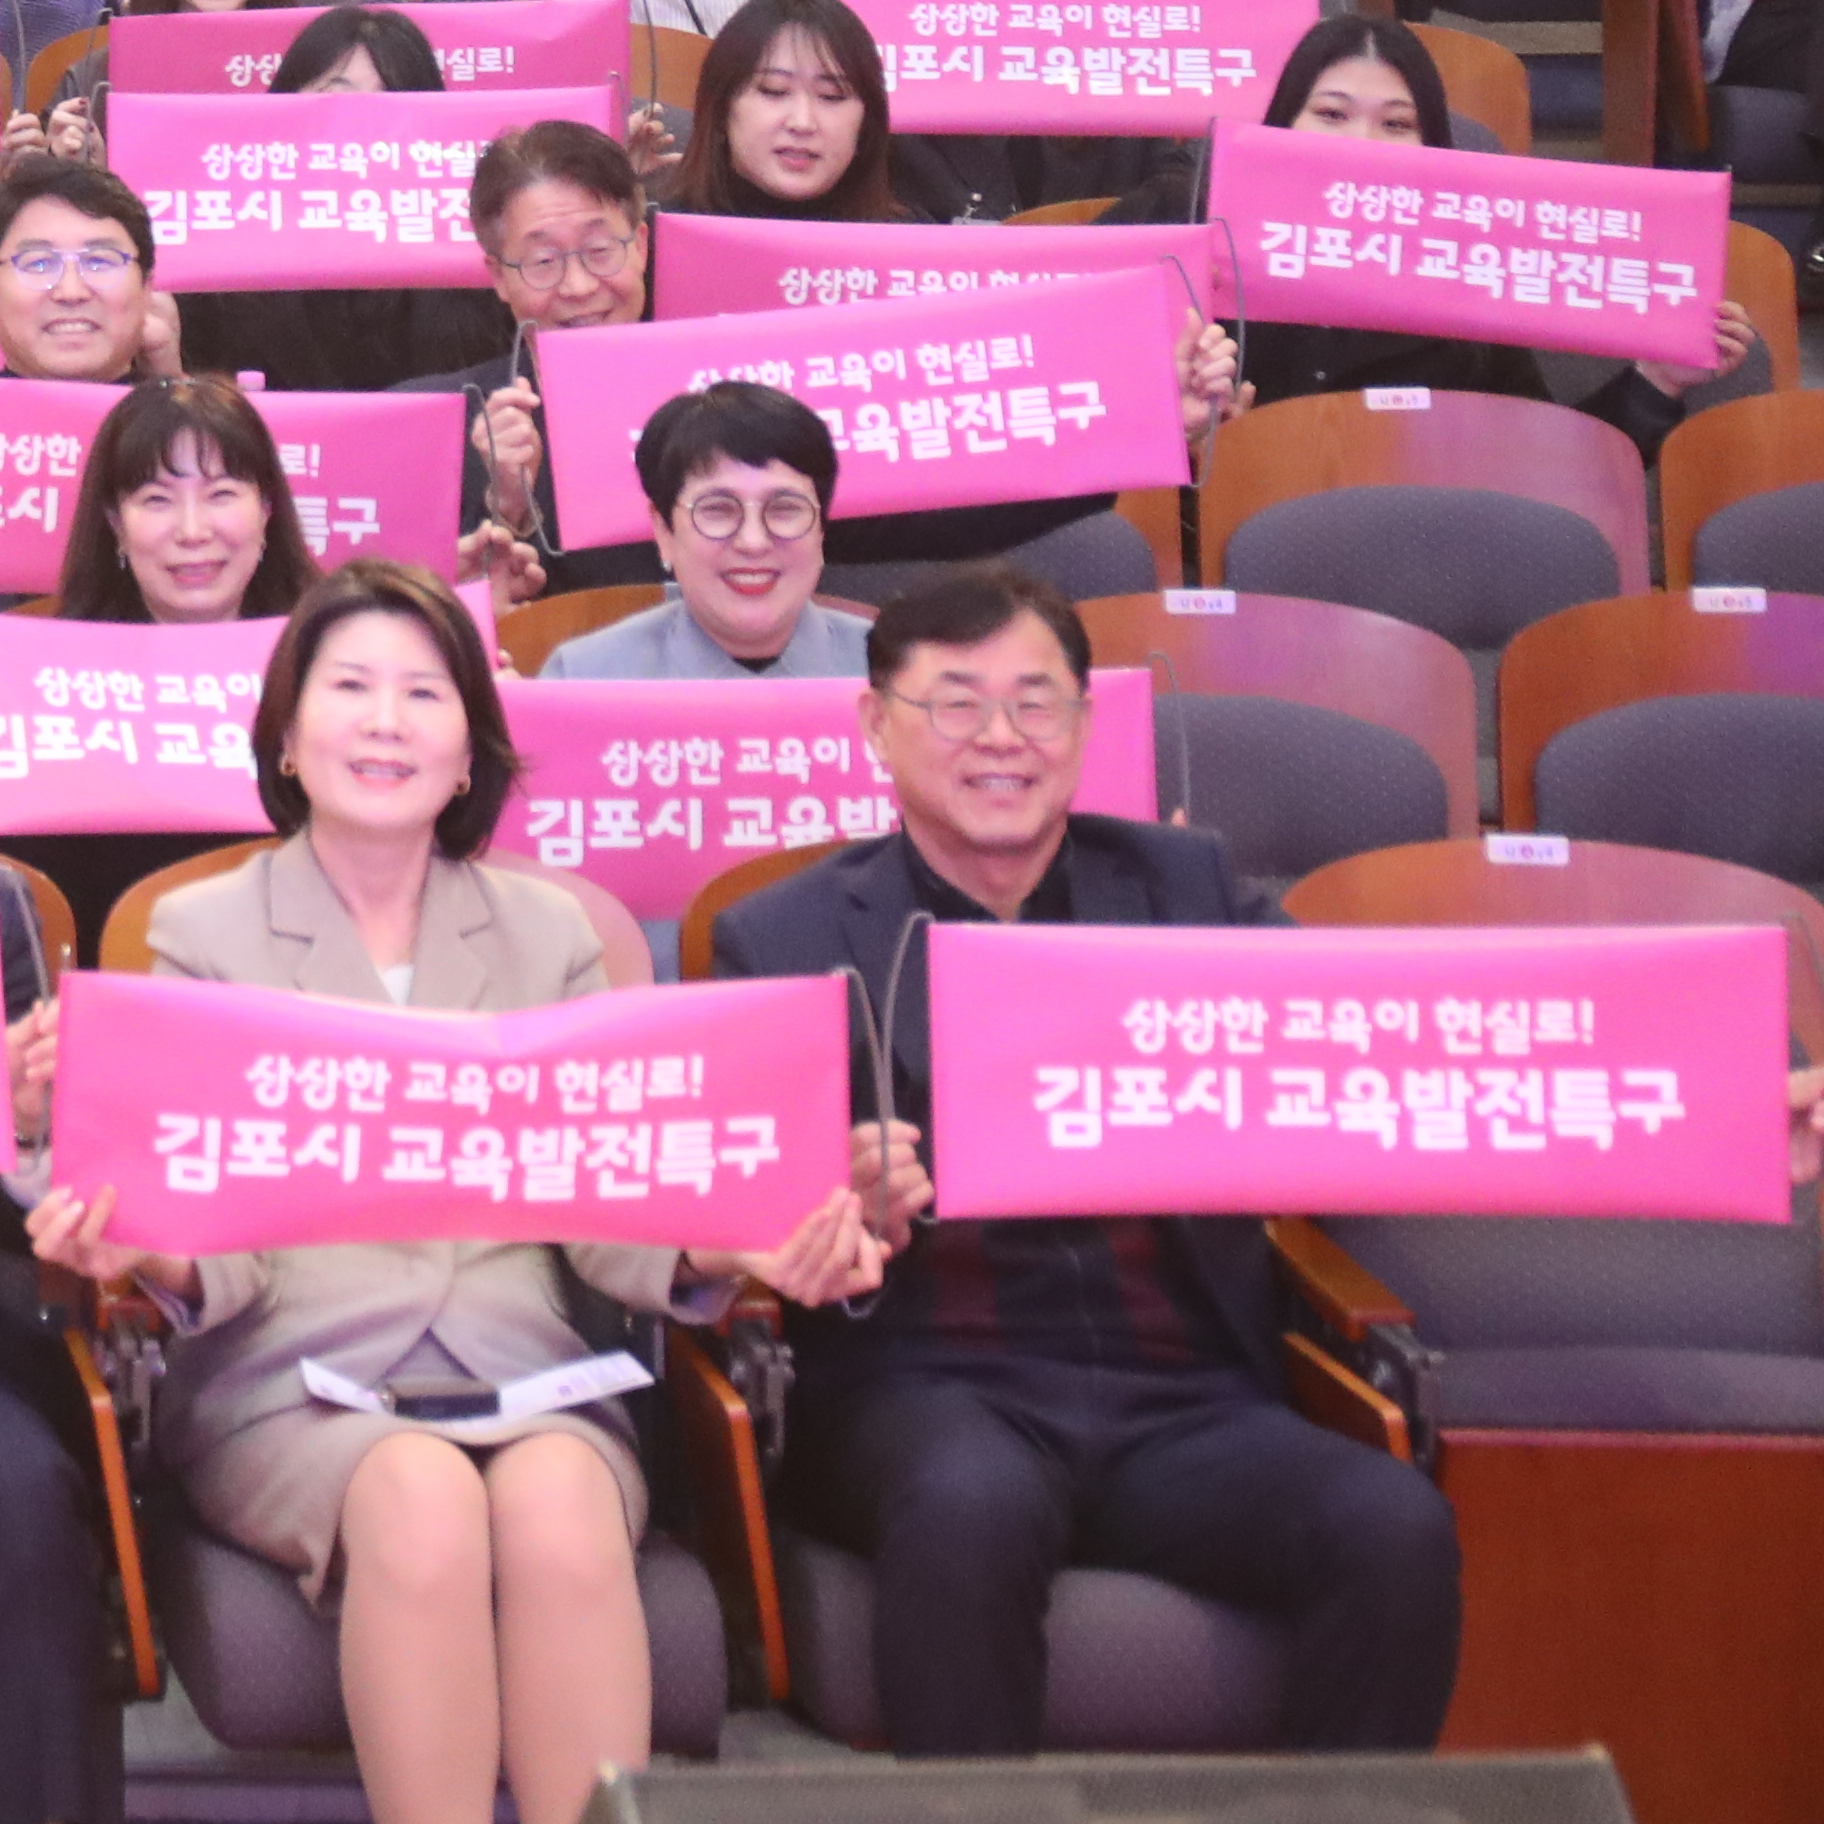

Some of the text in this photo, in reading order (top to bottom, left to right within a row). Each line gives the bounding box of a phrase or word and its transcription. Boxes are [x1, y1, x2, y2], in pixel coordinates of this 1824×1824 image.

[1323, 181, 1642, 245] 상상한 교육이 현실로!
[1258, 221, 1698, 315] 김포시 교육발전특구
[1121, 995, 1594, 1056] 상상한 교육이 현실로!
[244, 1053, 704, 1115] 상상한 교육이 현실로!
[1033, 1065, 1685, 1151] 김포시 교육발전특구
[153, 1113, 780, 1202] 김포시 교육발전특구
